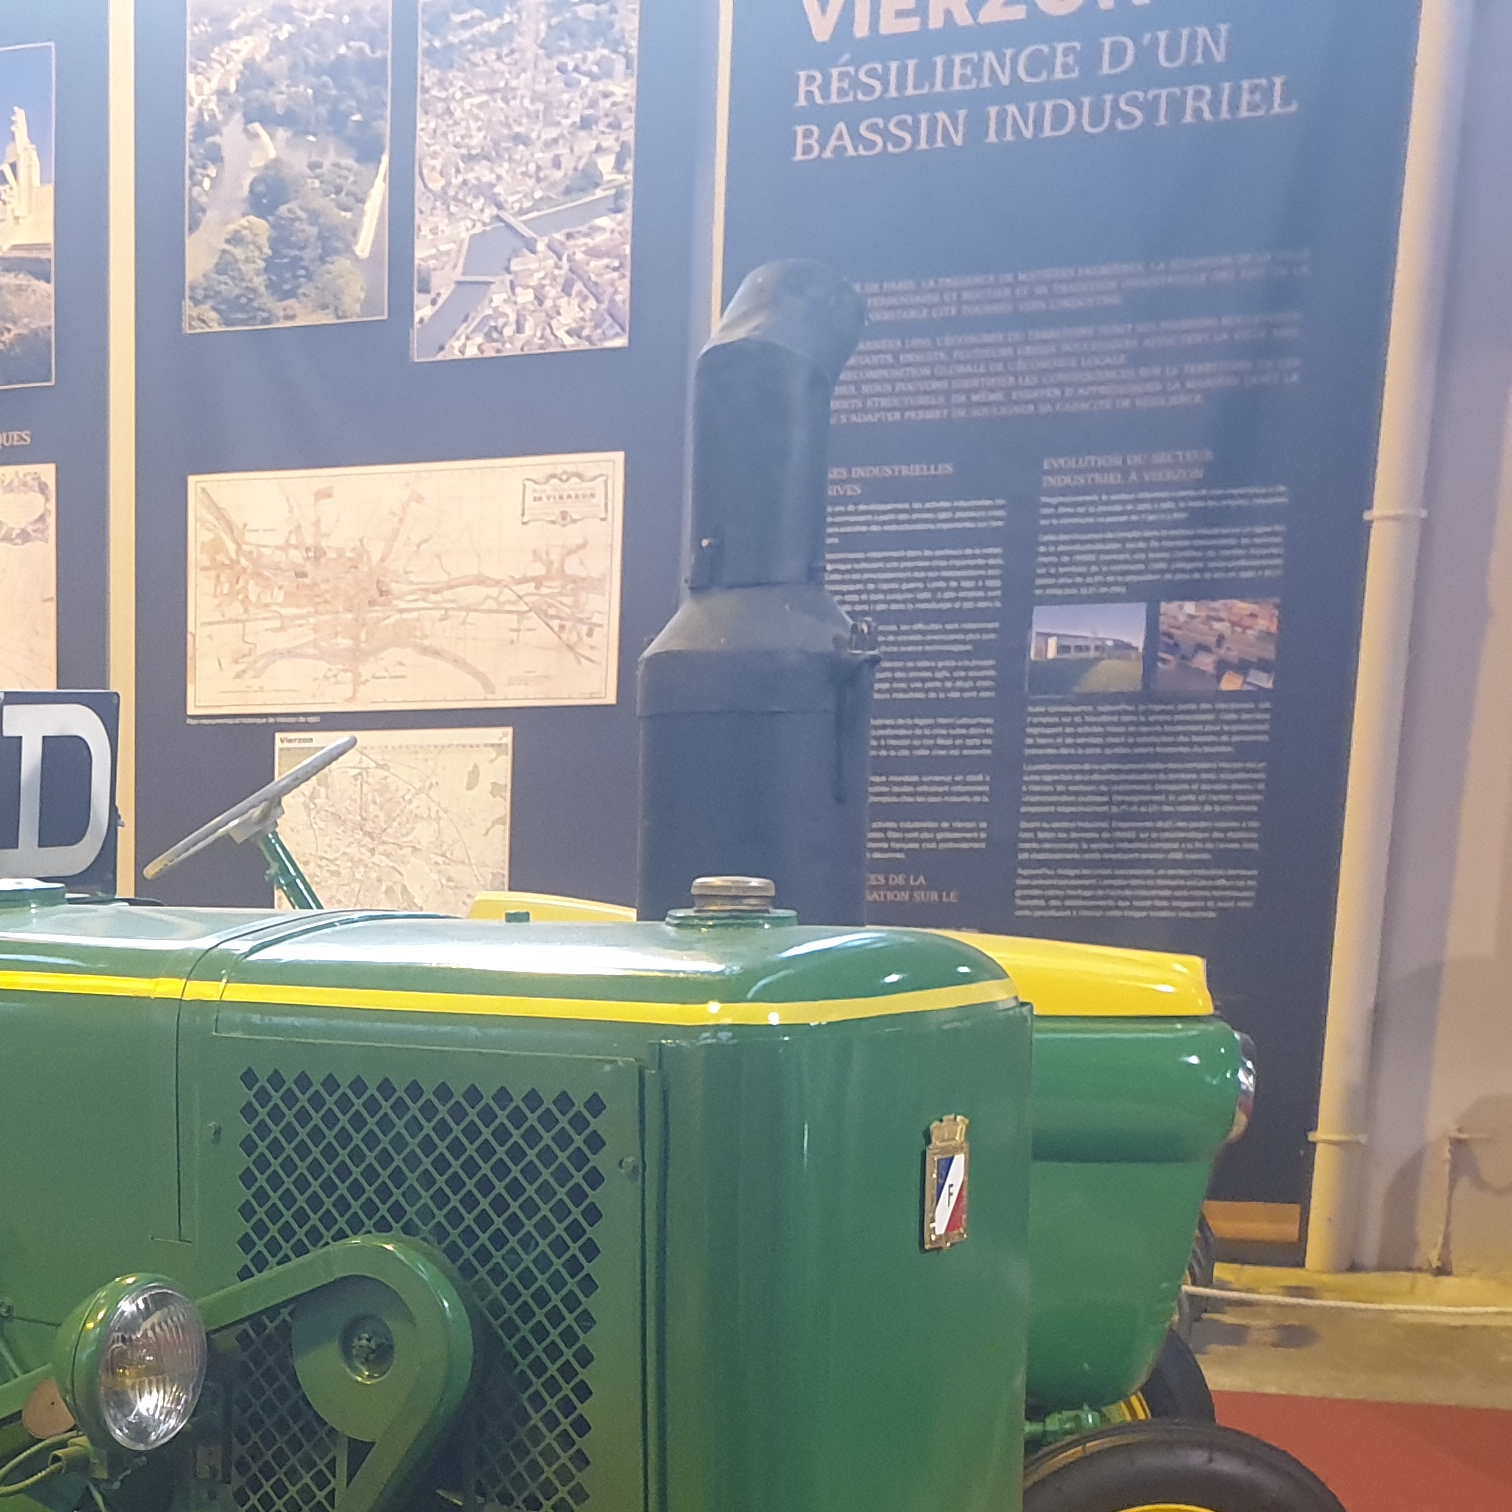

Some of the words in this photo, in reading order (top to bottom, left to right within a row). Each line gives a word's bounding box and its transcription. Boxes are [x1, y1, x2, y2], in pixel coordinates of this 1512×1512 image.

[794, 41, 1082, 108] RÉSILIENCE
[1099, 23, 1232, 77] D'UN
[792, 109, 968, 162] BASSIN
[984, 75, 1299, 144] INDUSTRIEL
[910, 874, 926, 886] LA
